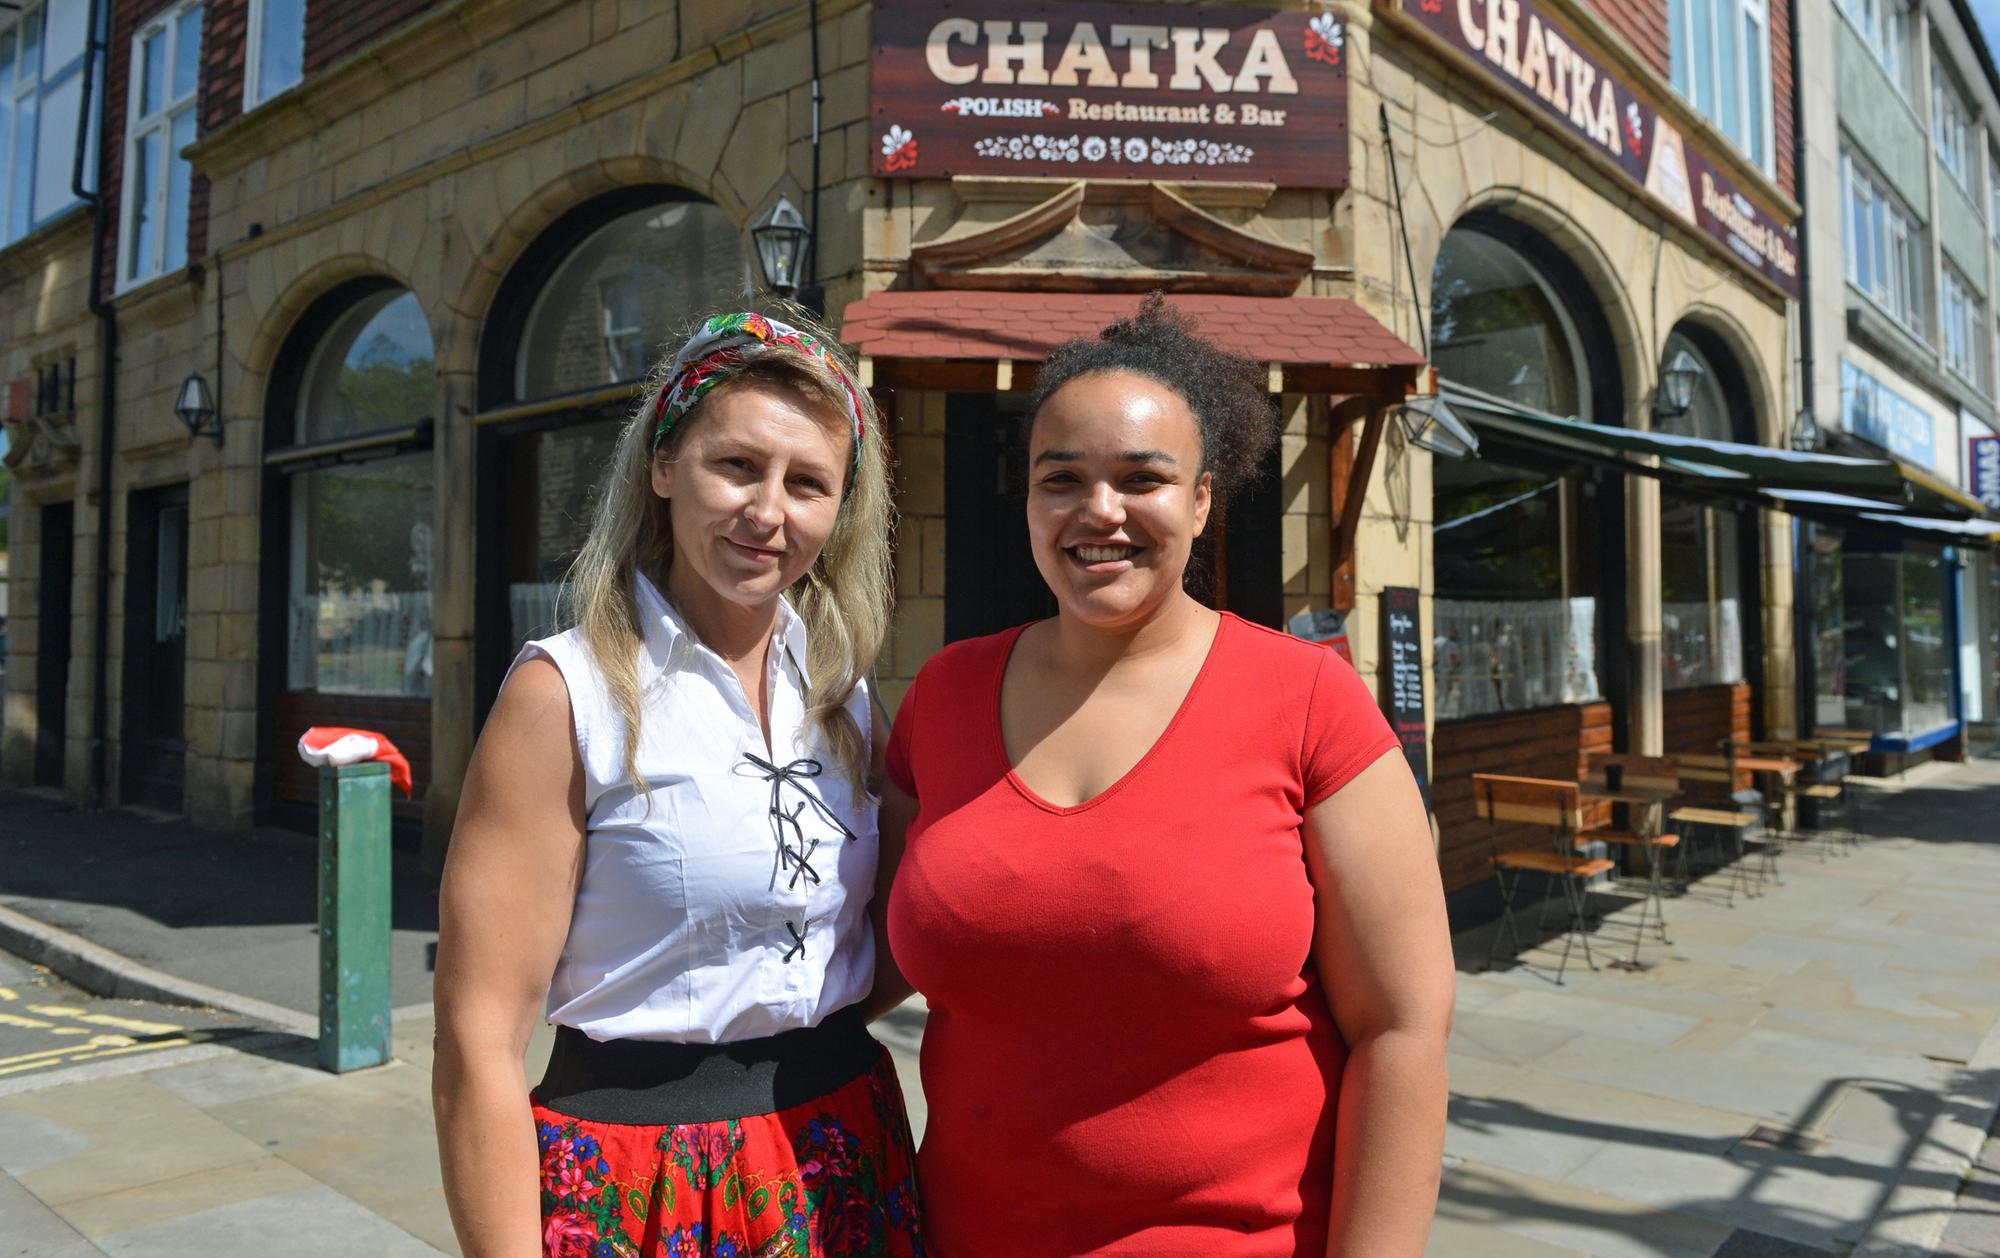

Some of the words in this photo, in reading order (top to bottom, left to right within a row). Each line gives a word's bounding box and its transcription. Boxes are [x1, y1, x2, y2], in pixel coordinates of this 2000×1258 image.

[926, 17, 1298, 95] CHATKA
[1457, 0, 1622, 156] CHATKA
[958, 98, 1043, 118] POLISH
[1069, 98, 1209, 124] Restaurant
[1214, 104, 1234, 123] &
[1241, 105, 1286, 126] Bar
